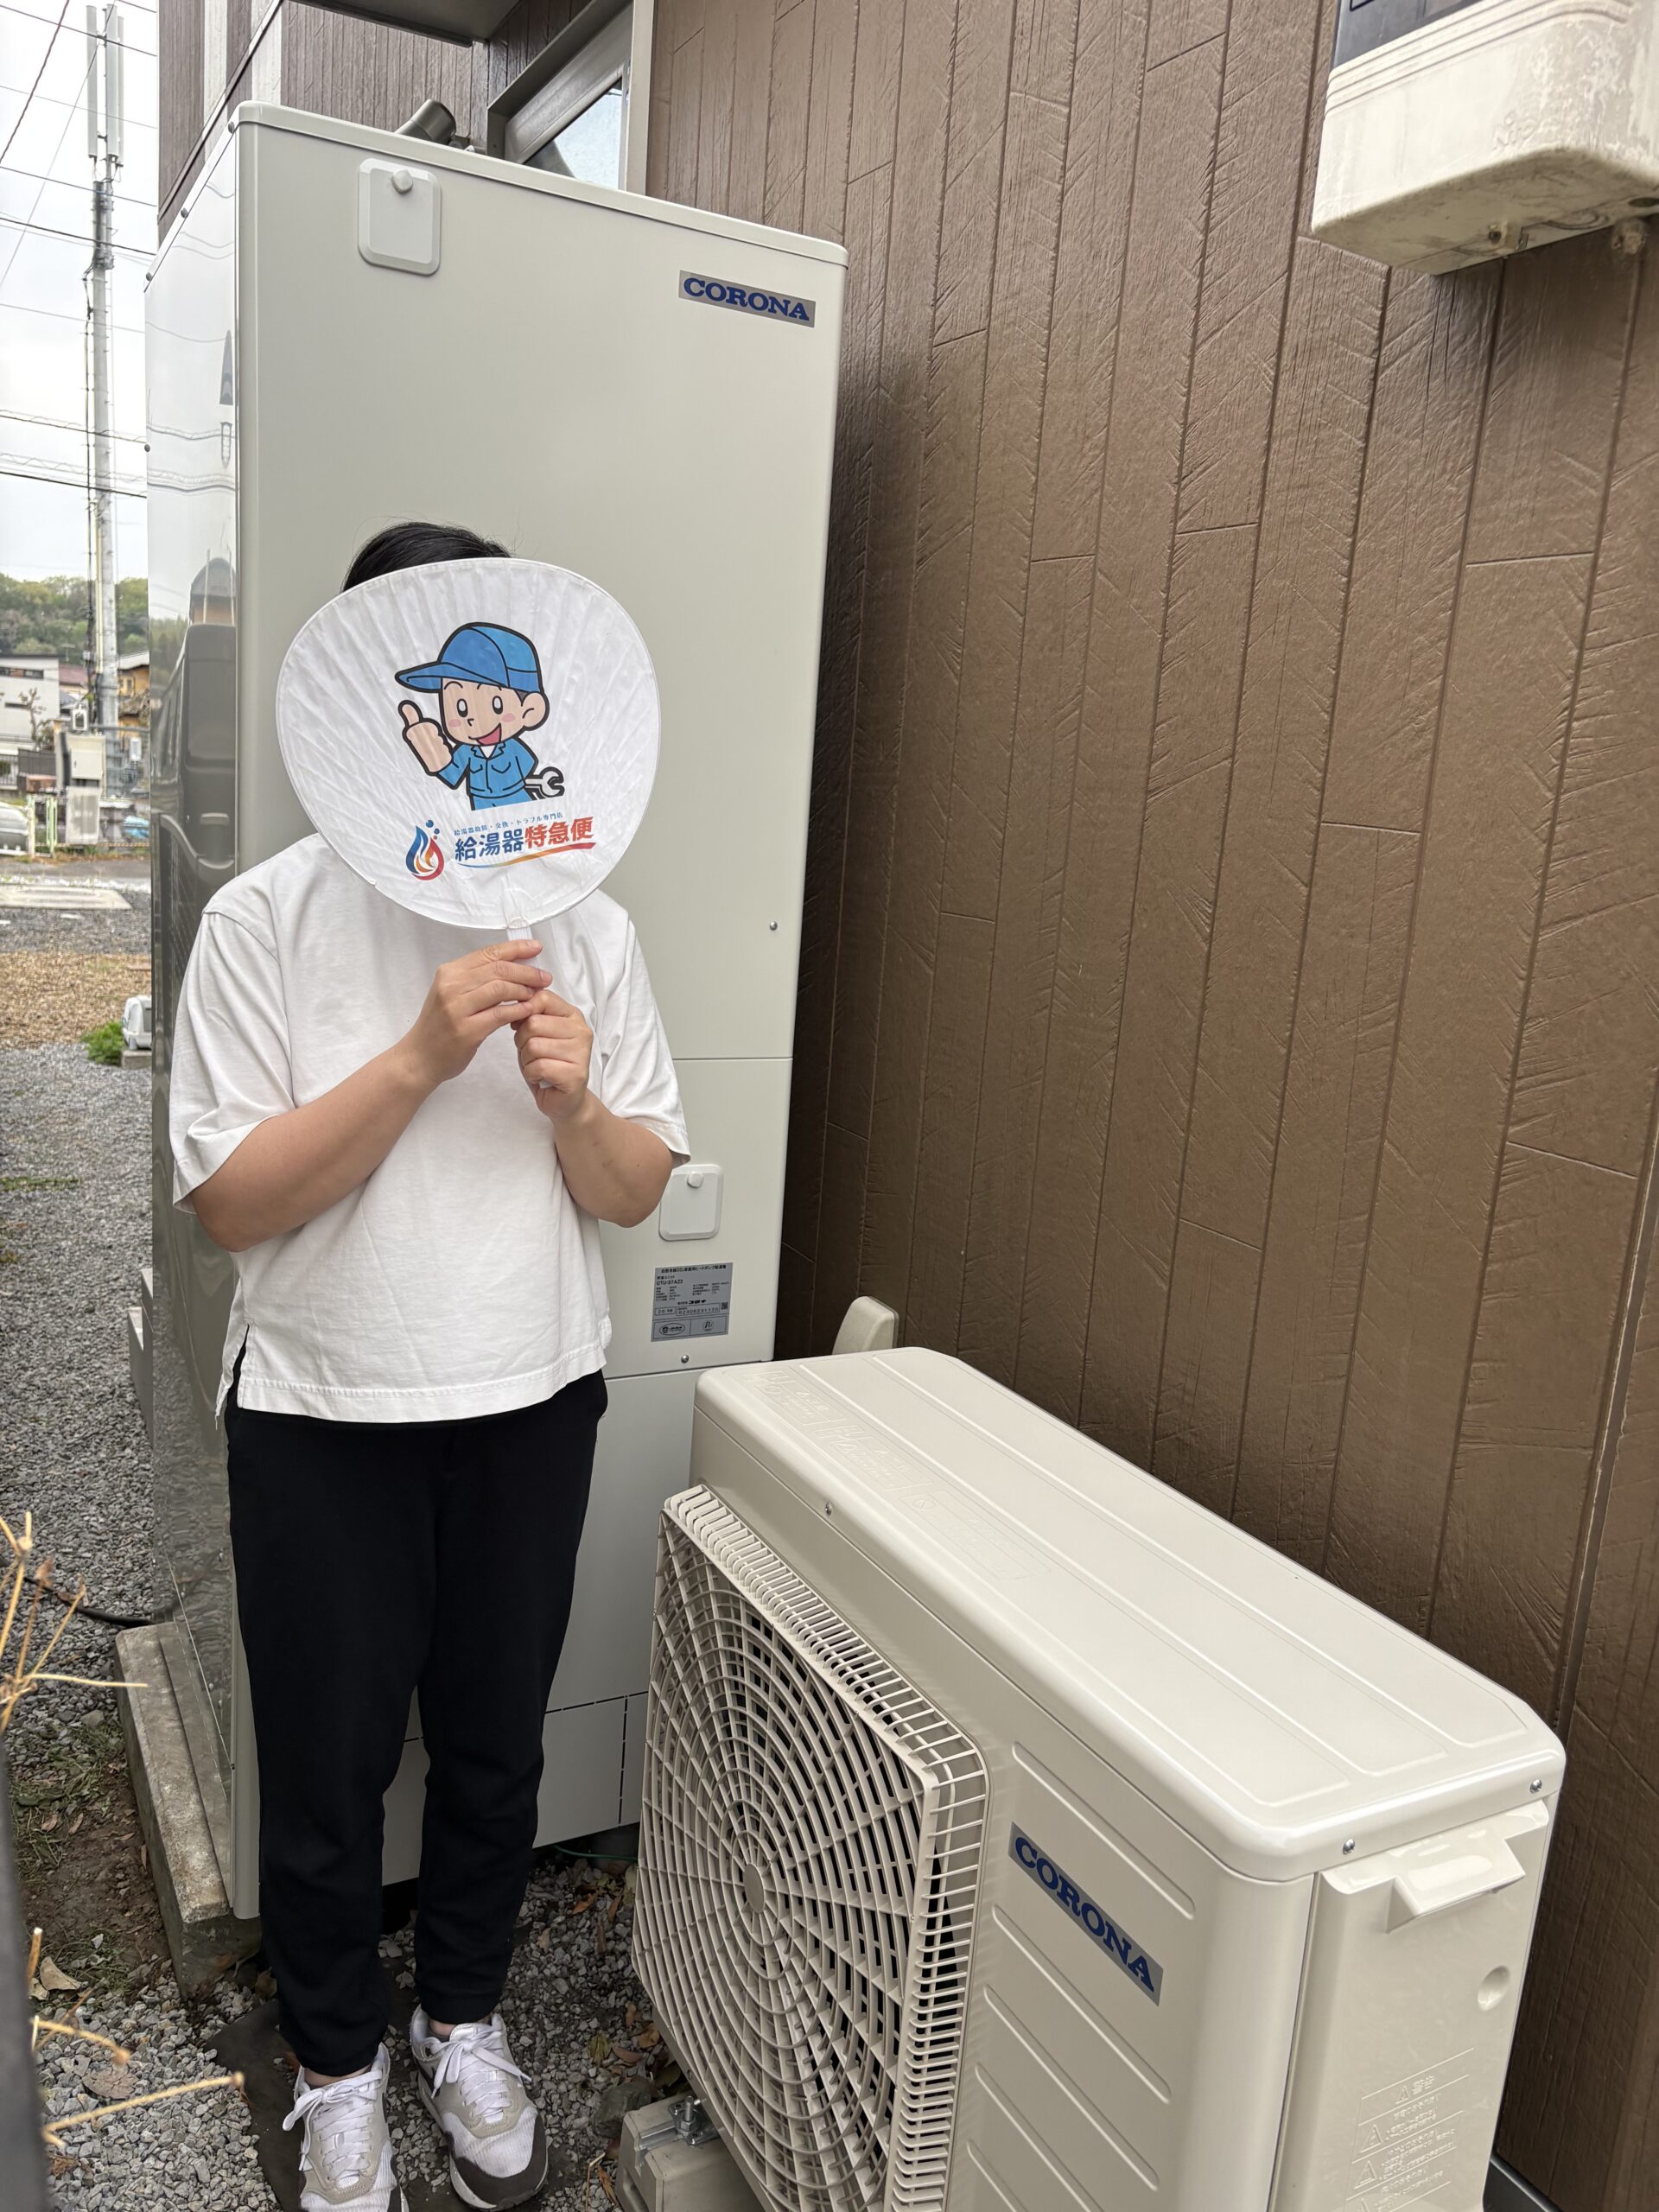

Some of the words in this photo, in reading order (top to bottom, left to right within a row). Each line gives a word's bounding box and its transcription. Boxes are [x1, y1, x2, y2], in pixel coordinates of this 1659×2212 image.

[683, 277, 810, 321] CORONA
[454, 816, 594, 861] 給湯器特急便
[1015, 1837, 1154, 1993] CORONA
